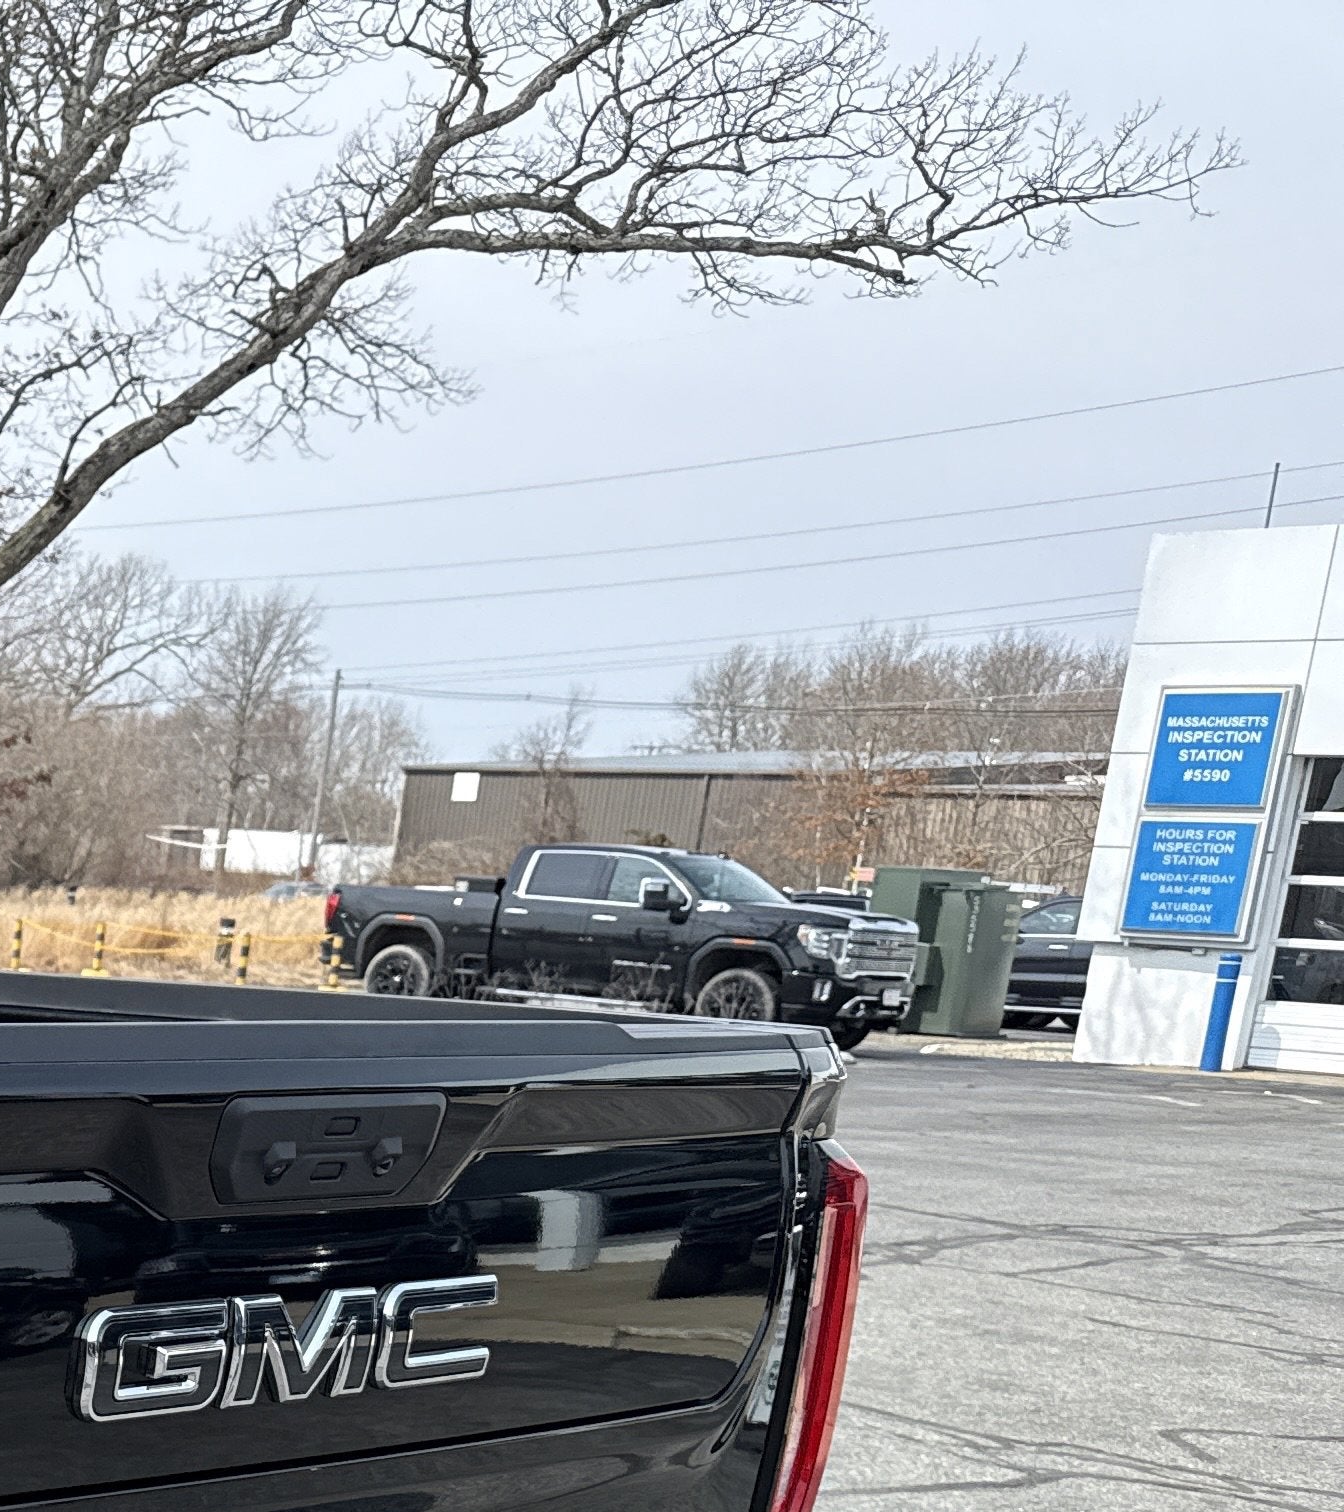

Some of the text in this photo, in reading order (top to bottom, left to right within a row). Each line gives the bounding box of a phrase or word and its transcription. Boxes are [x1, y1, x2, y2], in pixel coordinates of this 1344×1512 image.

[1167, 716, 1269, 727] MASSACHUSETTS
[1167, 731, 1262, 743] INSPECTION
[1178, 749, 1244, 762] STATION
[1183, 769, 1231, 782] #5590
[1156, 829, 1237, 841] HOURS FOR
[1153, 842, 1235, 854] INSPECTION
[1162, 855, 1220, 866] STATION
[1140, 872, 1236, 884] MONDAY-FRIDAY
[1151, 902, 1213, 912] SATURDAY
[67, 1274, 498, 1422] GMC
